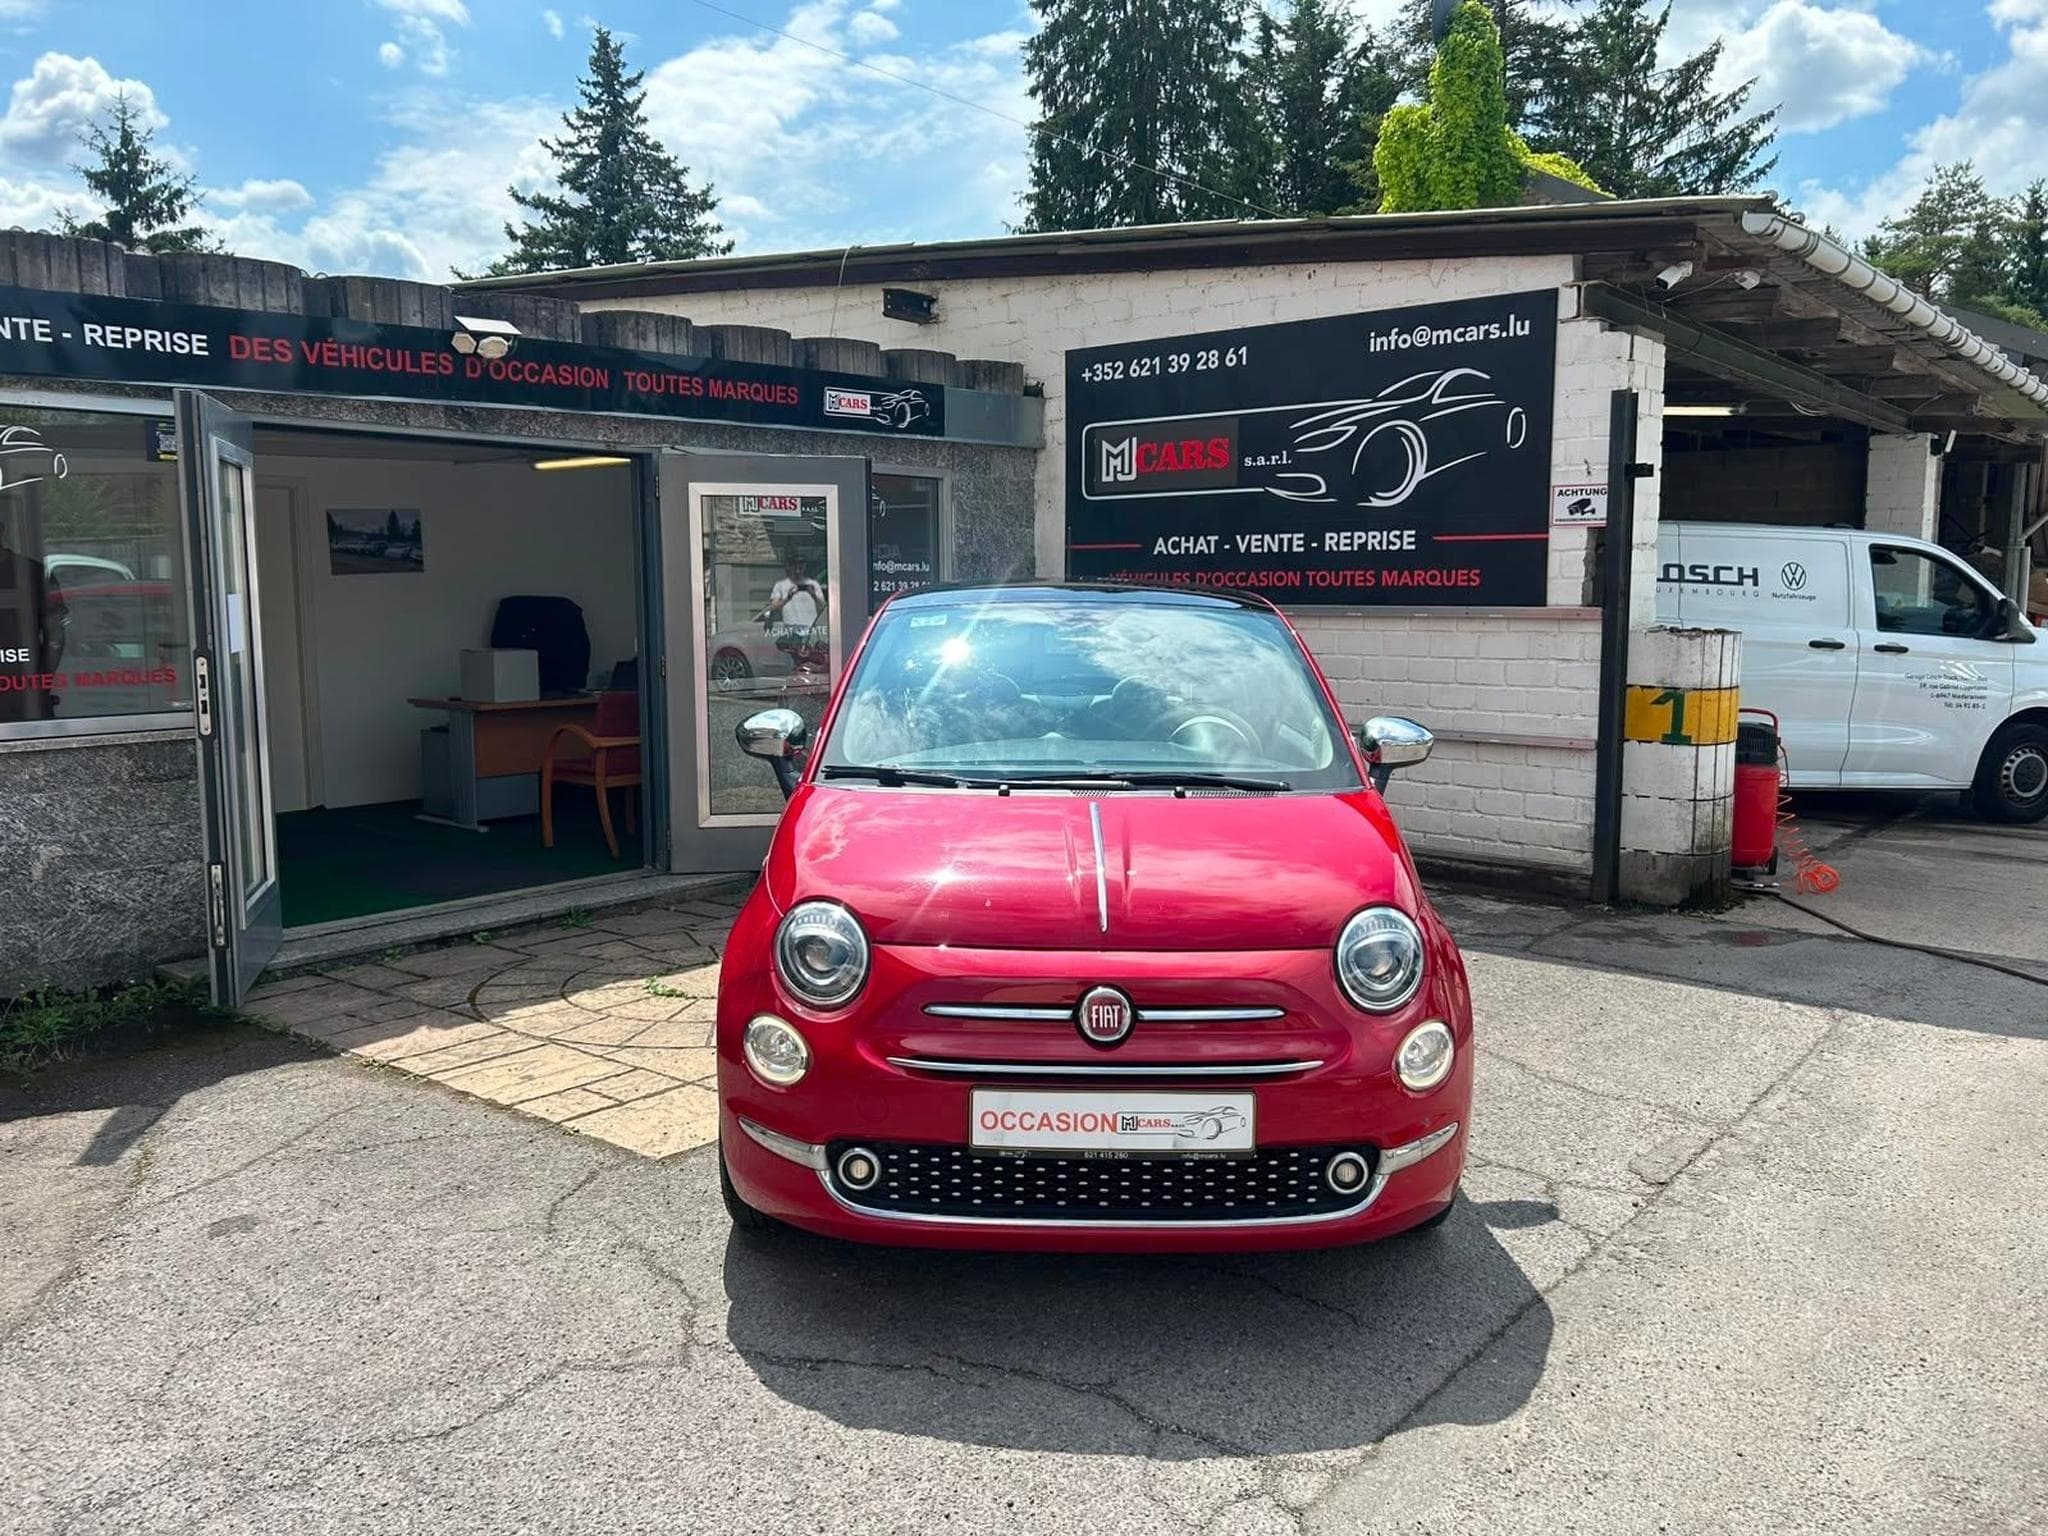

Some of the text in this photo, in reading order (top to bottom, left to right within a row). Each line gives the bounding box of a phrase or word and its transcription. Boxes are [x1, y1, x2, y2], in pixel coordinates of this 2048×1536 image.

[1369, 314, 1530, 352] info@mcars.lu
[0, 316, 53, 342] NTE
[83, 323, 209, 356] REPRISE
[229, 335, 293, 363] DES
[300, 338, 453, 375] VÉHICULES
[465, 357, 609, 389] D'OCCASION
[624, 371, 704, 396] TOUTES
[708, 378, 801, 405] MARQUES
[1081, 346, 1247, 382] +352 621 39 28 61
[1244, 451, 1292, 467] s.a.r.l.
[1557, 487, 1607, 497] ACHTUNG
[1153, 535, 1219, 555] ACHAT
[1235, 533, 1304, 553] VENTE
[1324, 530, 1416, 551] REPRISE
[1196, 570, 1301, 587] D'OCCASION
[1306, 571, 1376, 586] TOUTES
[1381, 569, 1481, 587] MARQUES
[1656, 563, 1759, 587] OSCH
[1650, 690, 1692, 745] 1
[1092, 1005, 1121, 1028] FIAT
[980, 1110, 1117, 1133] OCCASION
